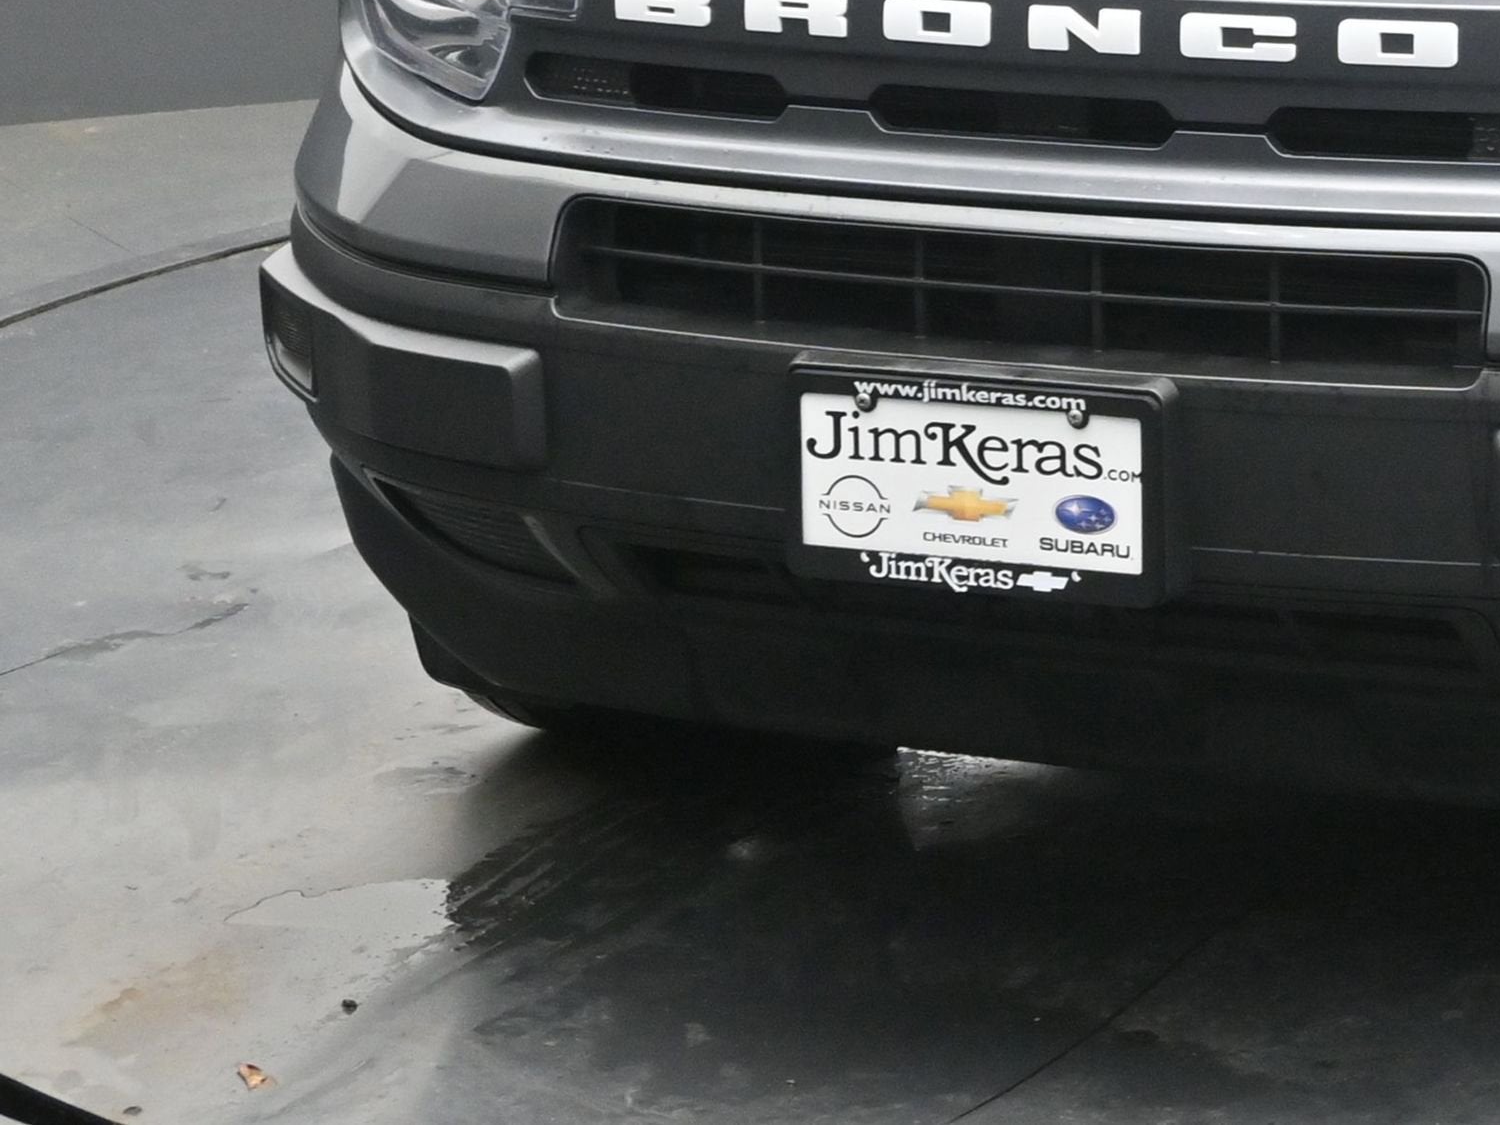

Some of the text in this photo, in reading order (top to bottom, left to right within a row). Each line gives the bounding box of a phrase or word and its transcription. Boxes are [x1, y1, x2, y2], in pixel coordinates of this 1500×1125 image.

[854, 380, 1087, 411] www.jimkeras.com
[818, 499, 891, 514] NISSAN
[923, 531, 1009, 549] CHEVROLET
[1039, 537, 1130, 559] SUBARU
